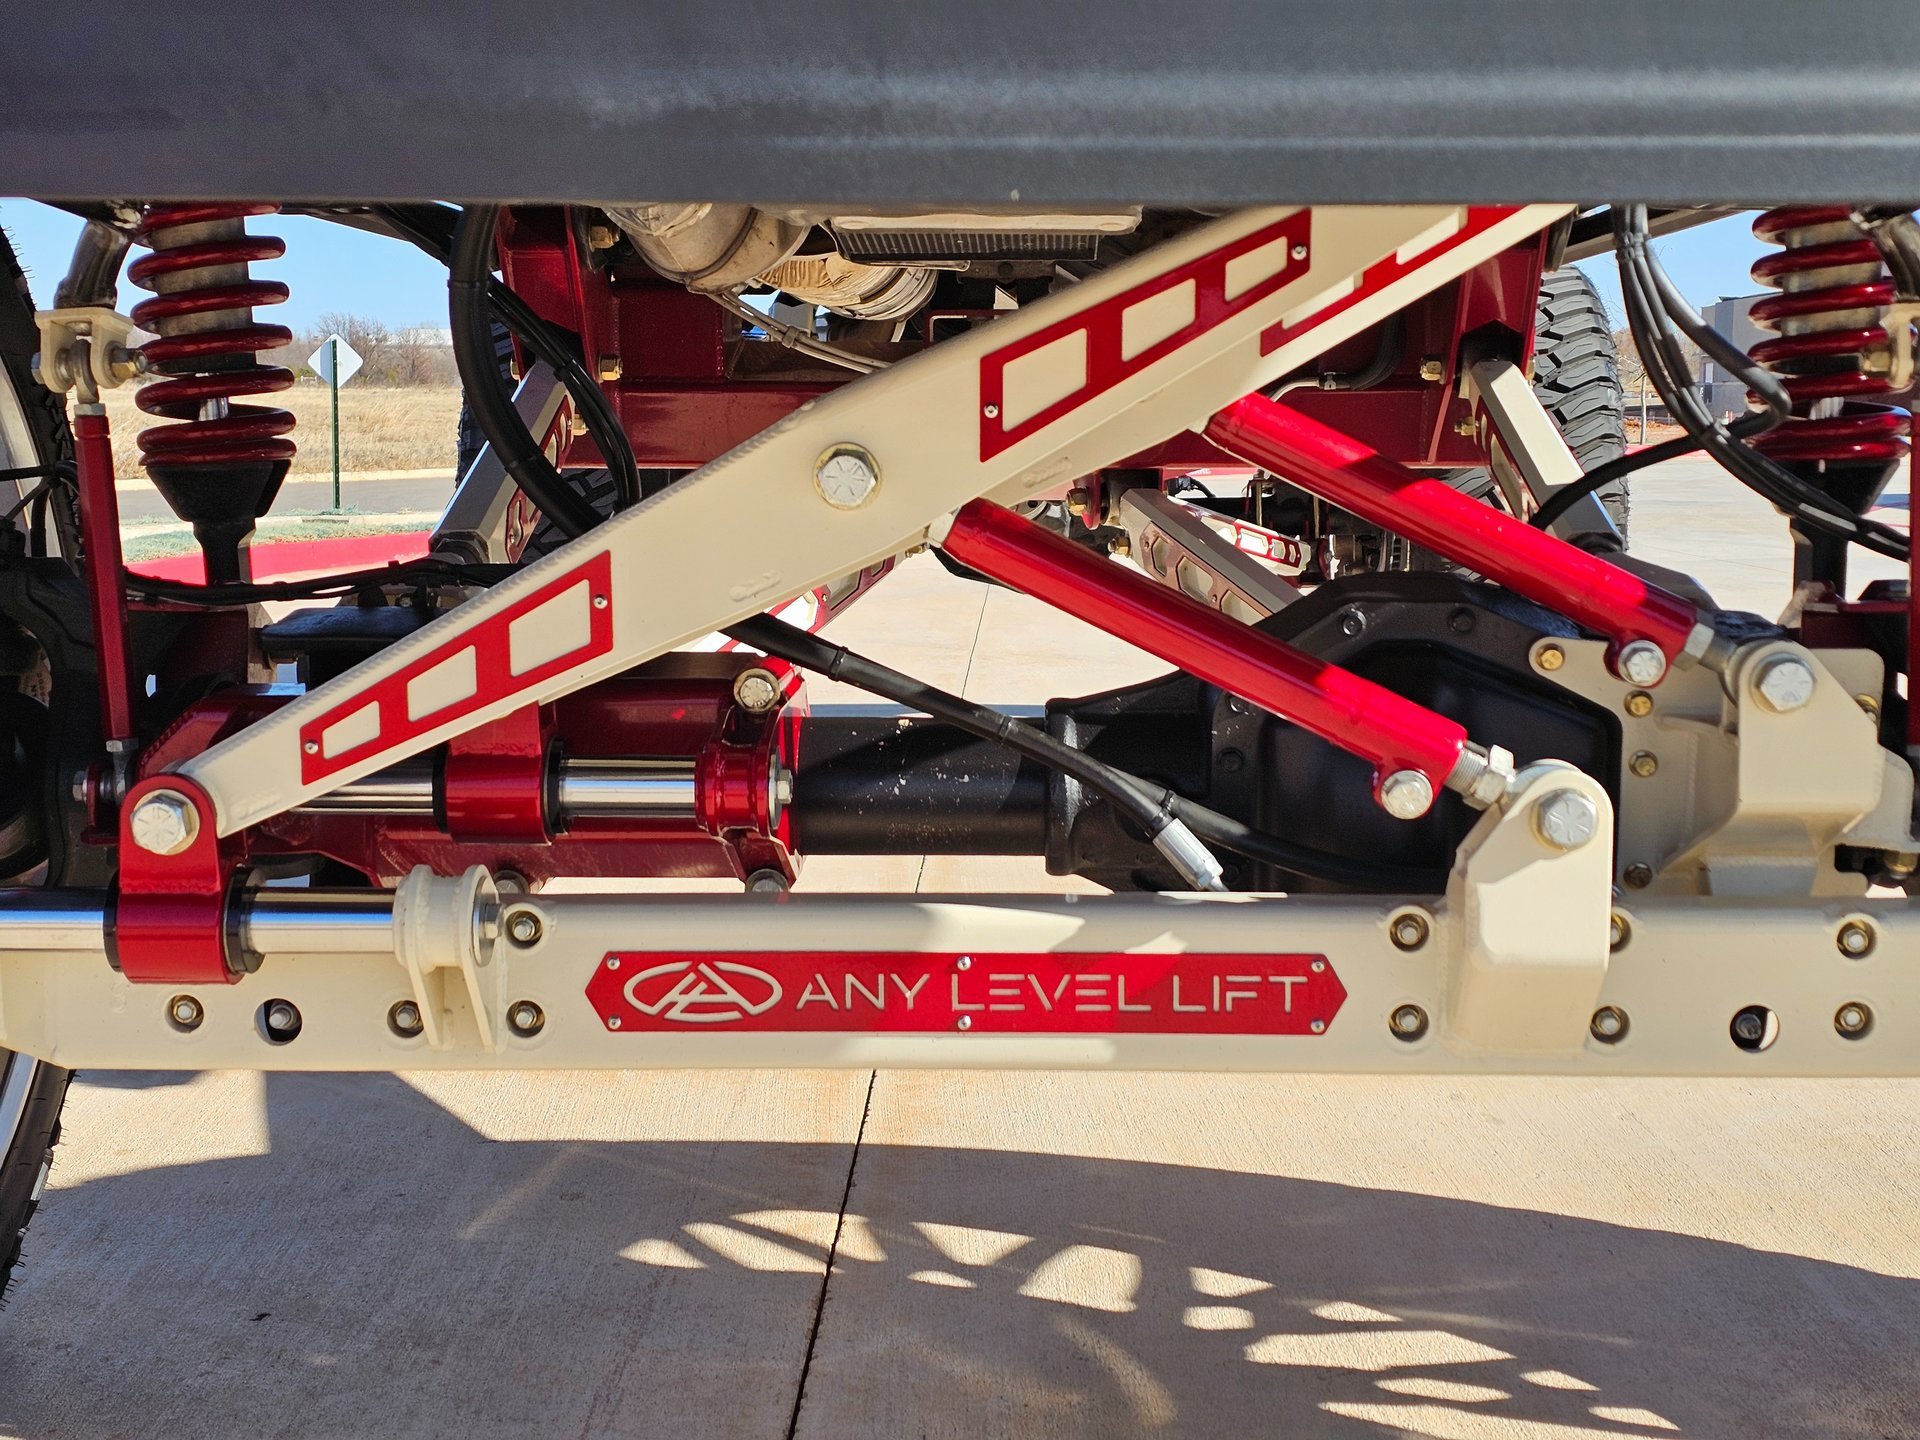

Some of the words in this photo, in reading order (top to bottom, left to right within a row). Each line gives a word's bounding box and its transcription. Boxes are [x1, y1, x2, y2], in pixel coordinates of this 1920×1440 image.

[796, 973, 931, 1010] ANY
[952, 974, 1152, 1011] LEVEL
[1173, 975, 1308, 1012] LIFT
